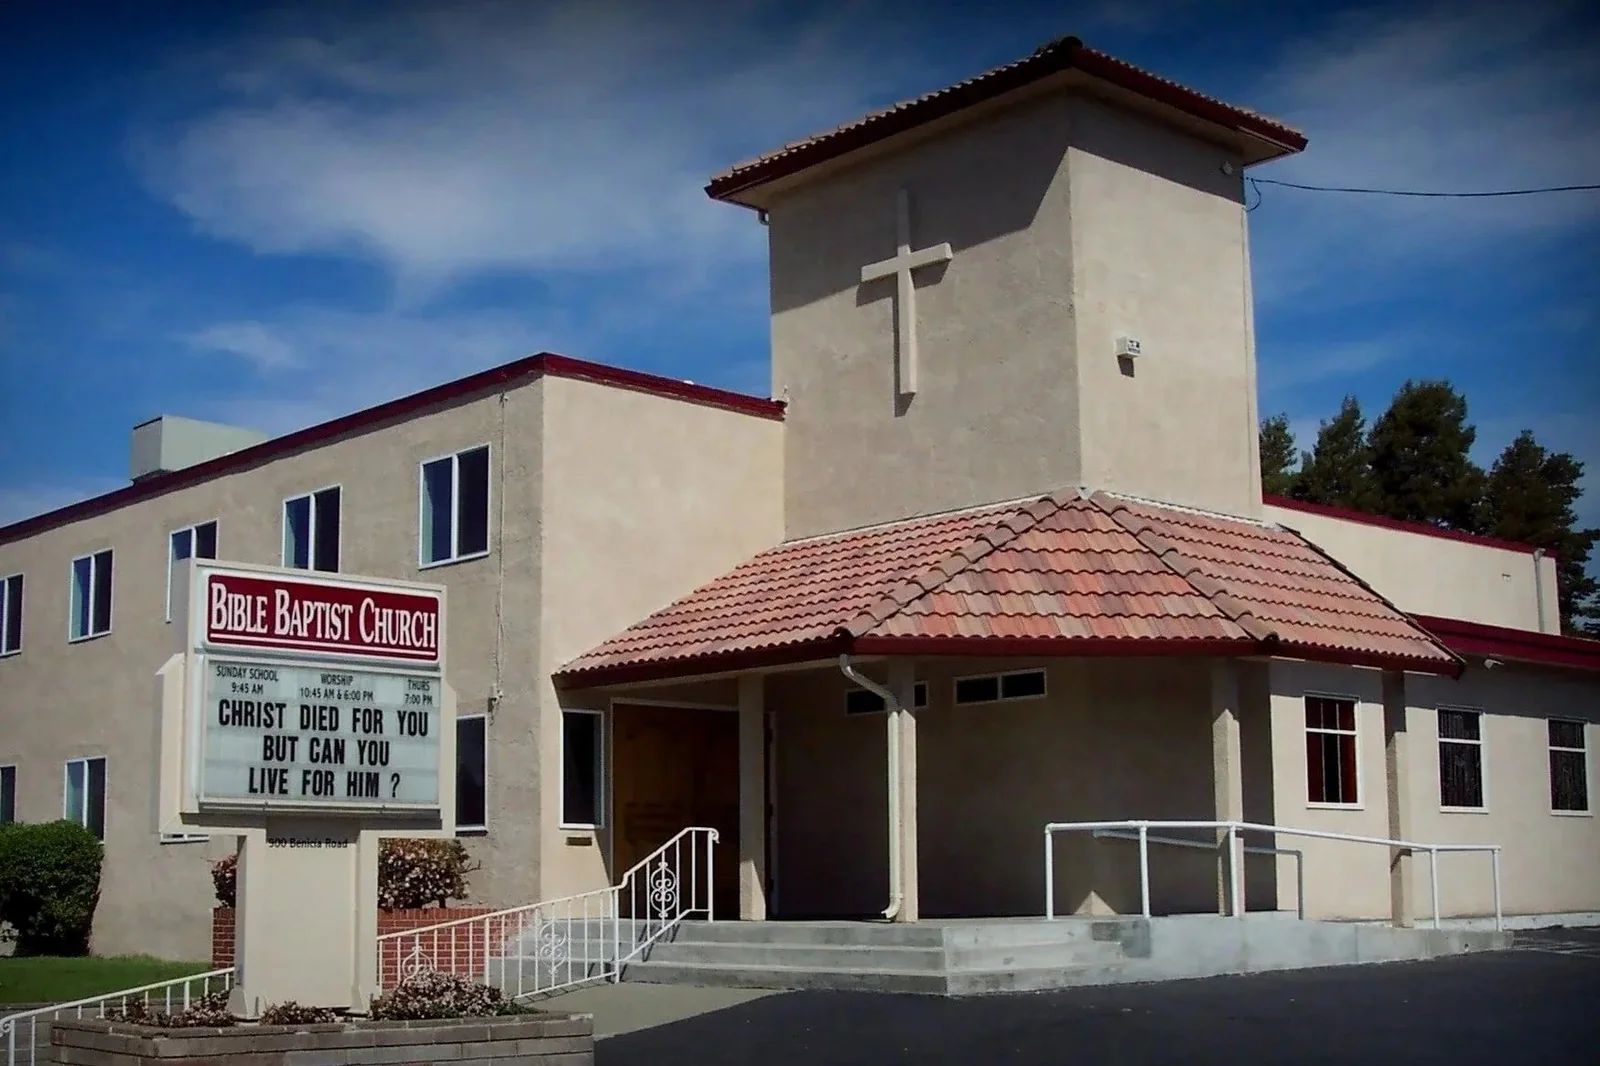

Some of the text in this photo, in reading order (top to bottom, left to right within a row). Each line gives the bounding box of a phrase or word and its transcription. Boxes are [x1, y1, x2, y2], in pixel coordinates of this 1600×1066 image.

[211, 583, 436, 648] BIBLE BAPTIST CHURCH
[216, 665, 278, 682] SUNDAY SCHOOL
[321, 674, 354, 685] WORSHIP
[231, 682, 264, 695] 9:45 AM
[408, 679, 430, 692] THURS
[300, 686, 374, 702] 10:45 AM & 6:00 PM
[405, 693, 433, 705] 7:00 PM
[219, 699, 428, 736] CHRIST DIED FOR YOU
[263, 735, 390, 766] BUT CAN YOU
[249, 767, 400, 798] LIVE FOR HIM ?
[289, 837, 322, 849] Benicia
[325, 838, 348, 849] Road
